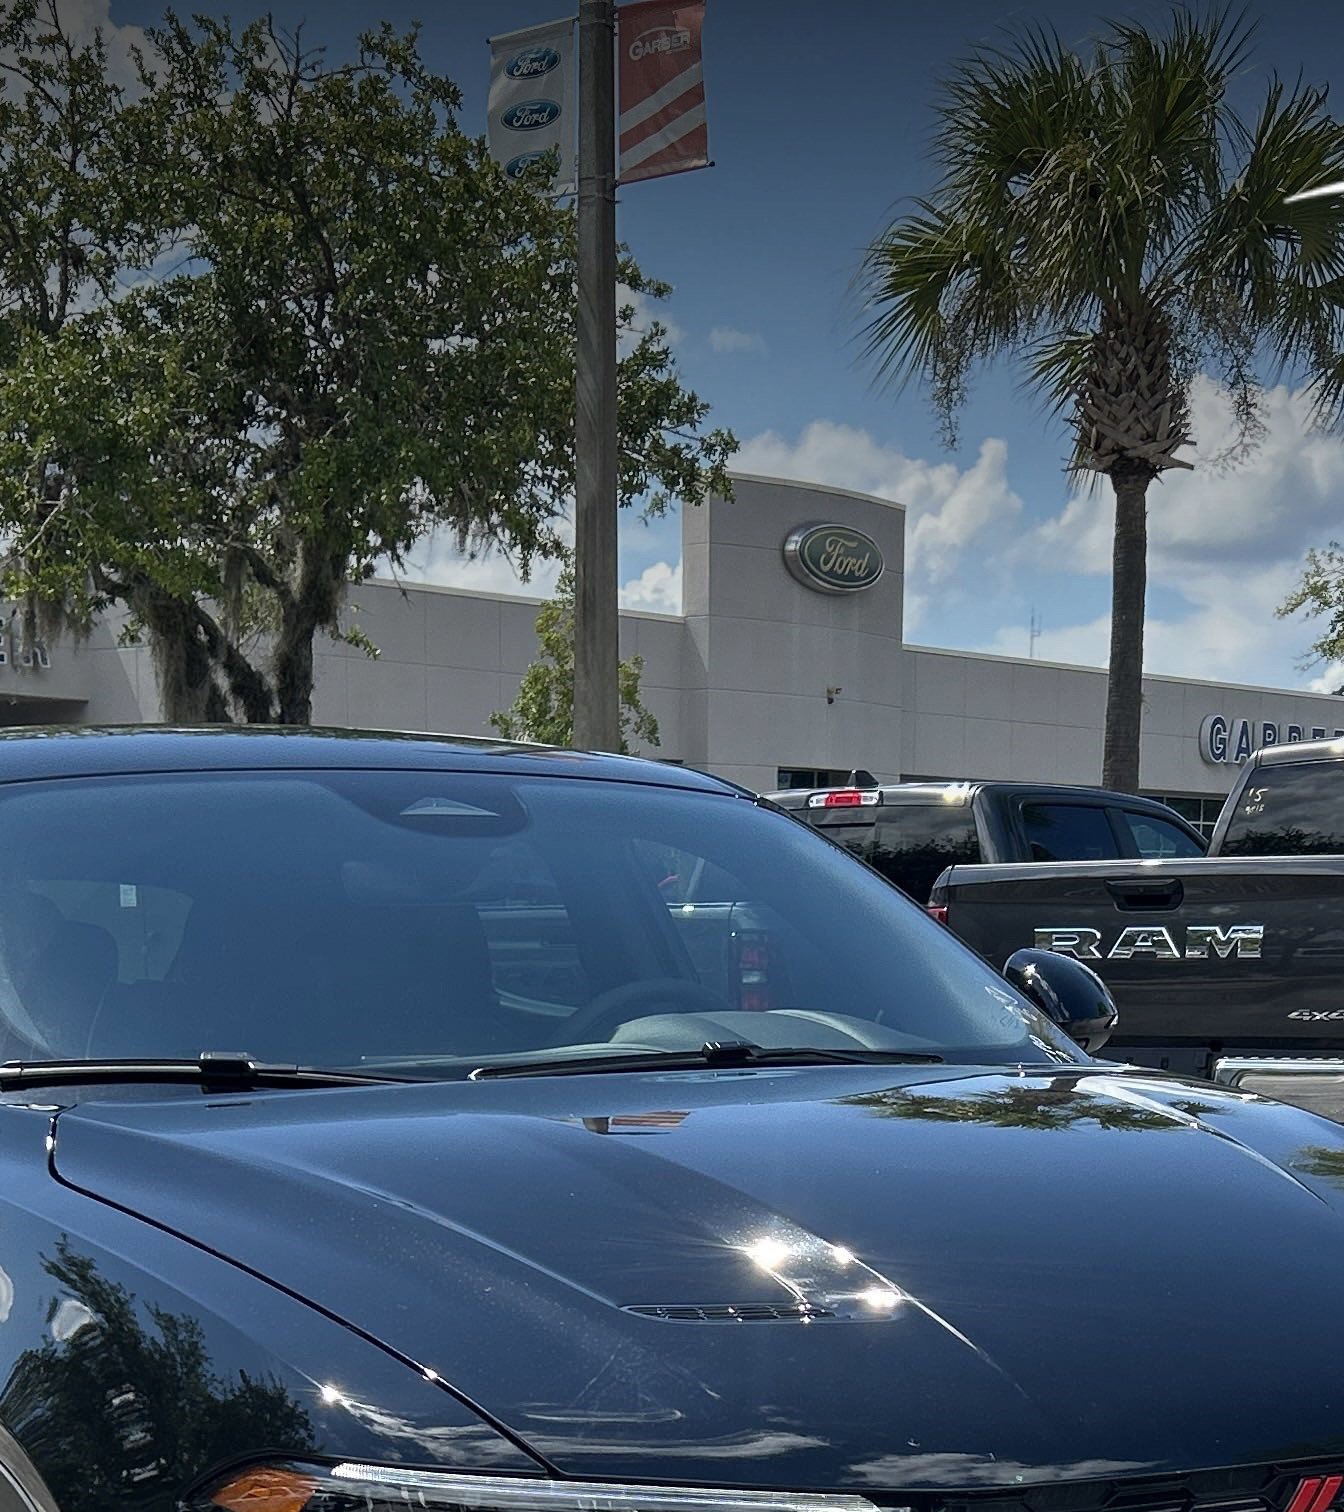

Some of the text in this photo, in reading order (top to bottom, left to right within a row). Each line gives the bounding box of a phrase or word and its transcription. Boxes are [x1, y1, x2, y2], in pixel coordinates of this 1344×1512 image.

[513, 54, 549, 76] Ford
[513, 104, 551, 127] Ford
[820, 536, 870, 577] Ford
[1033, 925, 1264, 960] RAM
